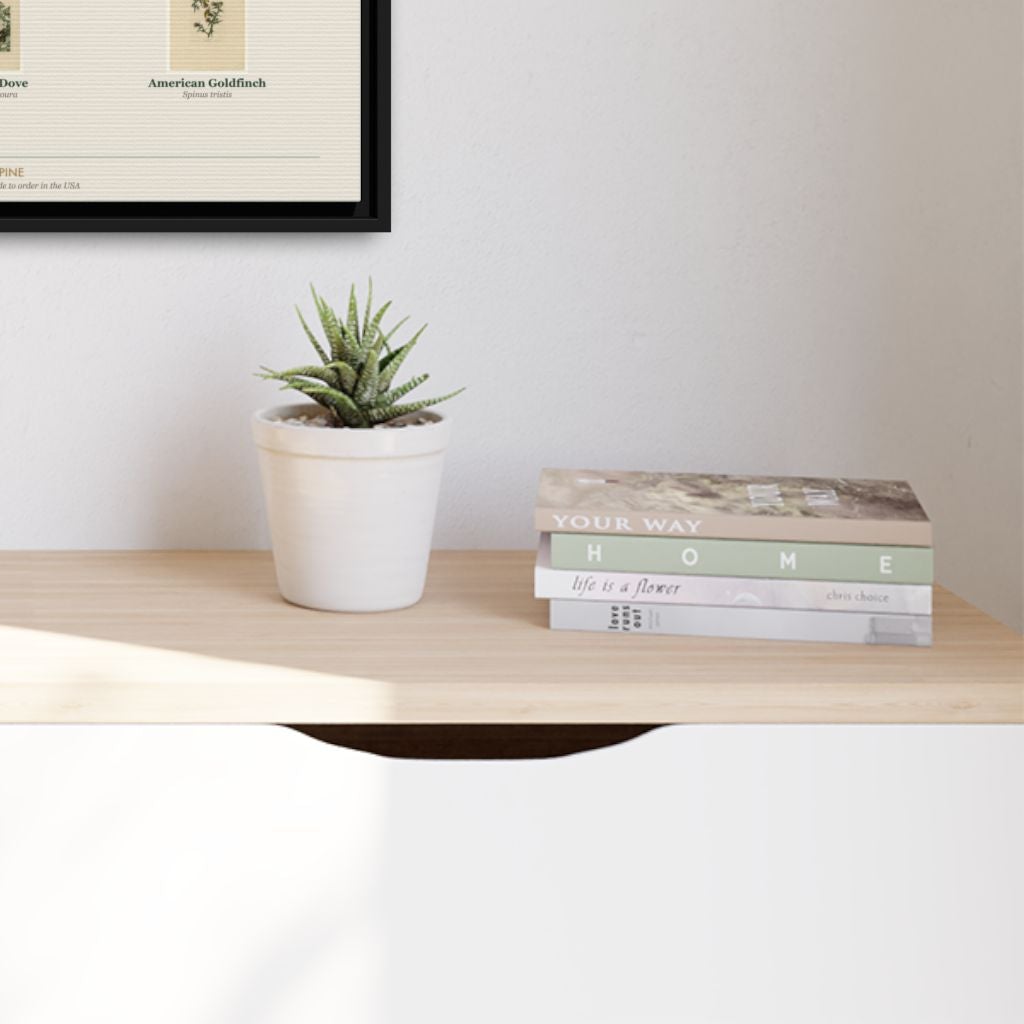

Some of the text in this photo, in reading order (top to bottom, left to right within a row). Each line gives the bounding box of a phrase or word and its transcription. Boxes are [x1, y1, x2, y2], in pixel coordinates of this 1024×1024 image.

[0, 79, 29, 88] Dove
[148, 78, 266, 88] American Goldfinch
[182, 91, 208, 100] Spinus
[0, 167, 24, 177] PINE
[17, 181, 38, 190] order
[40, 181, 48, 190] in
[50, 181, 61, 190] the
[63, 181, 81, 190] USA
[553, 515, 702, 533] YOUR WAY
[588, 544, 893, 574] HOME
[572, 575, 681, 599] life is a flower
[827, 589, 889, 602] chris choice
[608, 606, 619, 629] love
[632, 609, 641, 628] out
